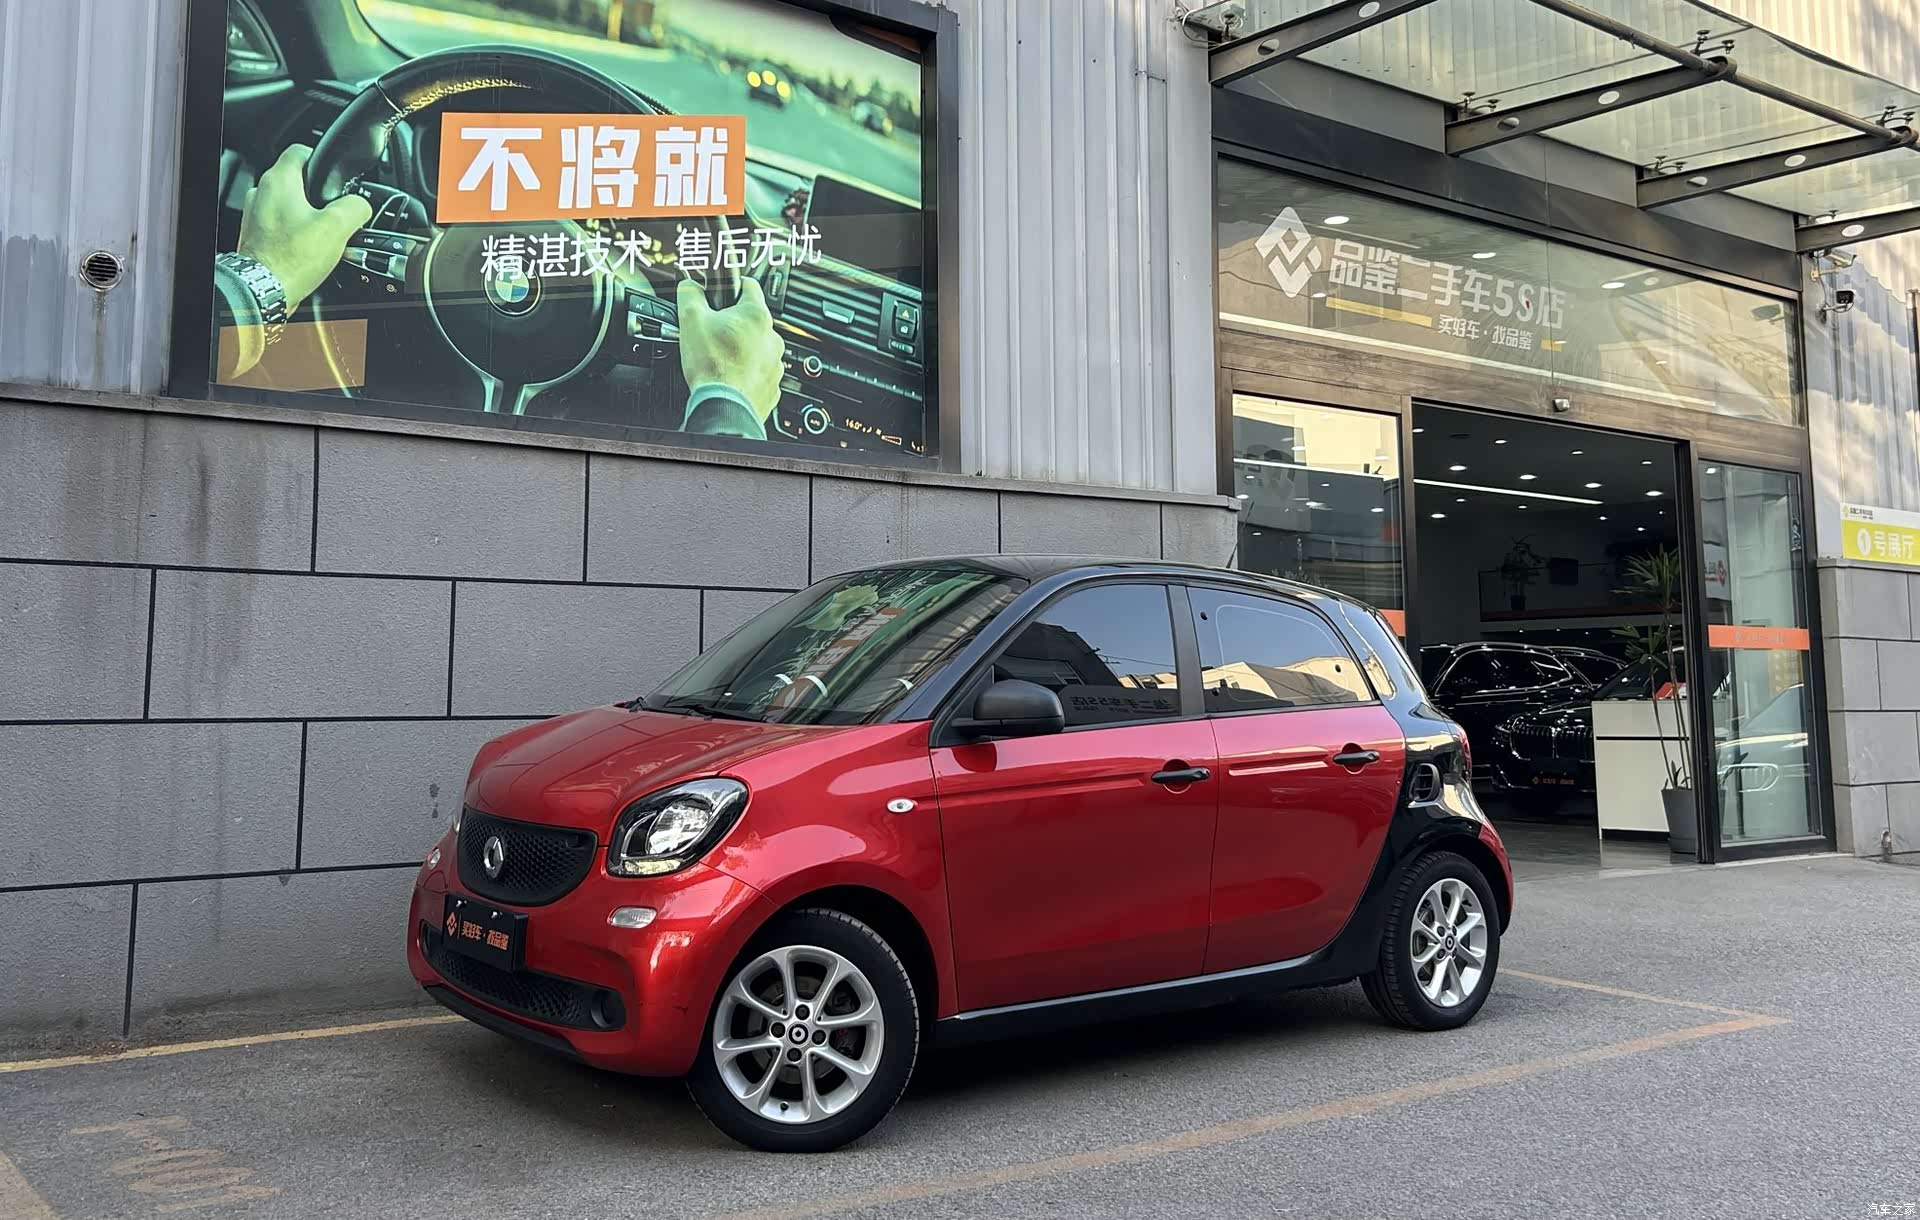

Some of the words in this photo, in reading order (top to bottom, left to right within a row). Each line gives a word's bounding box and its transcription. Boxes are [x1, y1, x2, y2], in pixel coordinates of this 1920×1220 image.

[457, 126, 728, 211] 不将就
[480, 229, 653, 282] 精湛技术
[674, 223, 822, 272] 售后无忧
[1328, 238, 1568, 330] 品鉴二手车5S店
